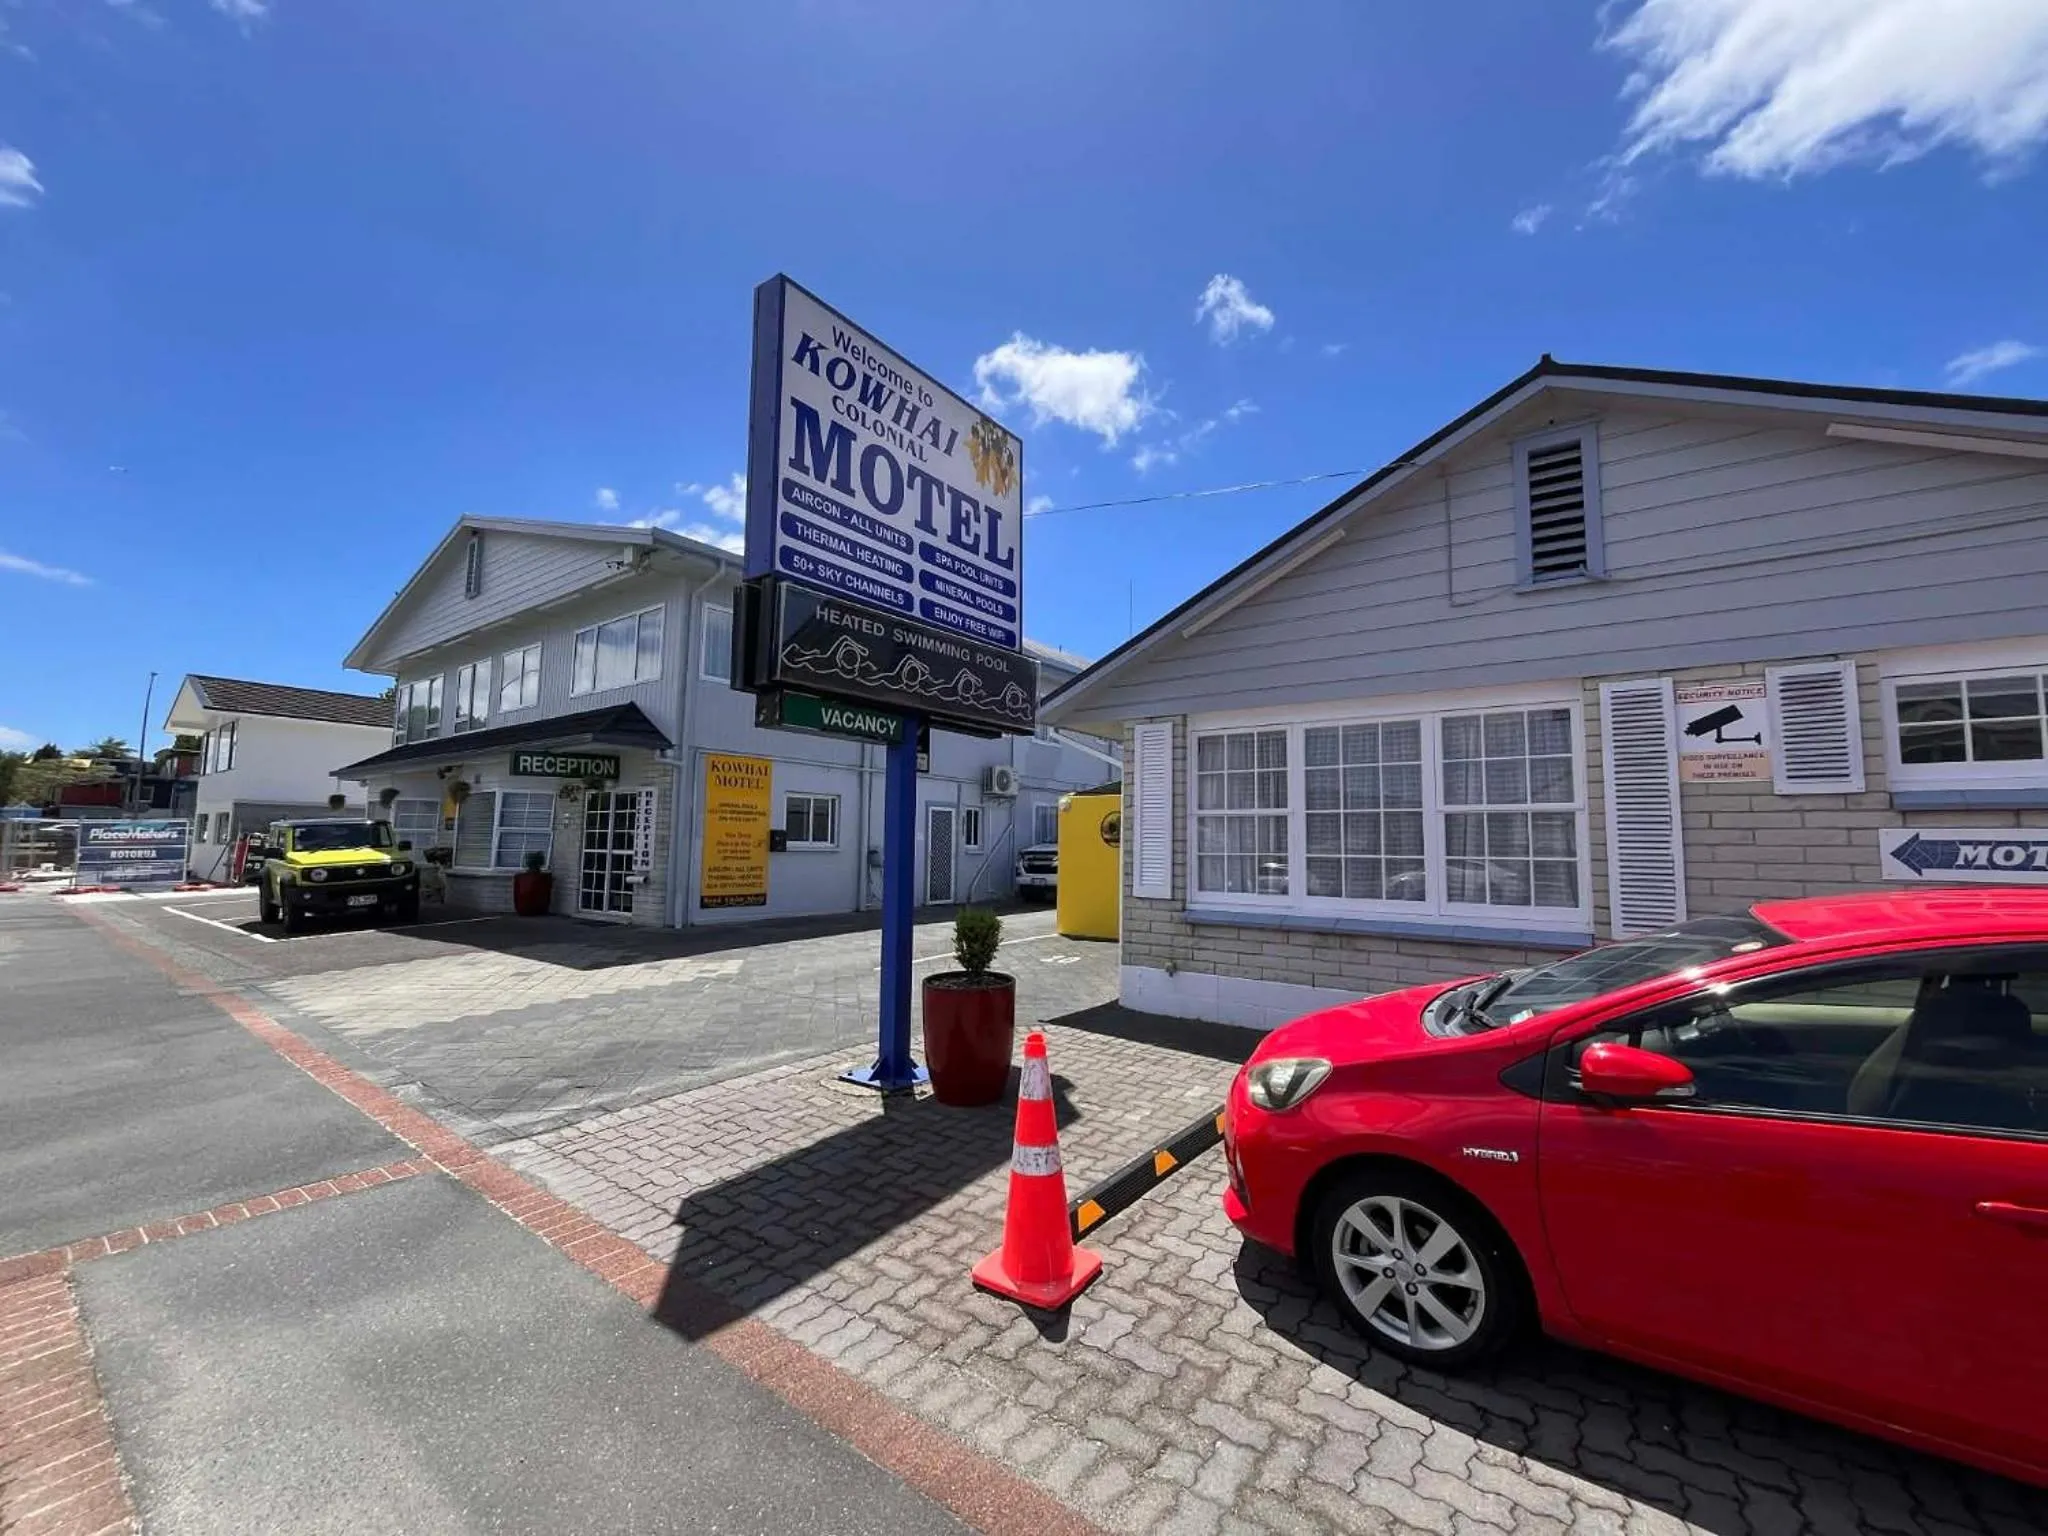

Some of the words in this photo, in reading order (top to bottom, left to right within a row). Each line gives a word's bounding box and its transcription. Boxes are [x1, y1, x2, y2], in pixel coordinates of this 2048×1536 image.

[832, 325, 914, 395] Welcome
[918, 384, 934, 408] to
[791, 332, 960, 458] KOWHAI
[832, 394, 929, 463] COLONIAL
[788, 396, 1015, 572] MOTEL
[791, 487, 841, 519] AIRCON
[850, 513, 873, 534] ALL
[875, 524, 907, 547] UNITS
[795, 521, 854, 557] THERMAL
[856, 547, 904, 576] HEATING
[793, 555, 815, 572] 50+
[817, 564, 842, 583] SKY
[845, 574, 905, 605] CHANNELS
[935, 552, 953, 569] SPA
[954, 560, 978, 580] POOL
[979, 571, 1004, 590] UNITS
[935, 579, 974, 604] MINERAL
[975, 595, 1003, 616] POOLS
[815, 604, 885, 637] HEATED
[893, 628, 971, 662] SWIMMING
[976, 652, 1011, 673] POOL
[934, 607, 963, 626] ENJOY
[964, 619, 987, 635] FREE
[1677, 690, 1723, 700] SECURITY
[1727, 687, 1764, 697] NOTICE
[820, 706, 897, 736] VACANCY
[518, 755, 615, 776] RECEPTION
[711, 759, 769, 777] KOWHAI
[713, 774, 765, 790] MOTEL
[88, 826, 179, 840] PlaceMakers
[110, 849, 158, 859] ROTORUA
[1462, 1147, 1509, 1162] HYBRID
